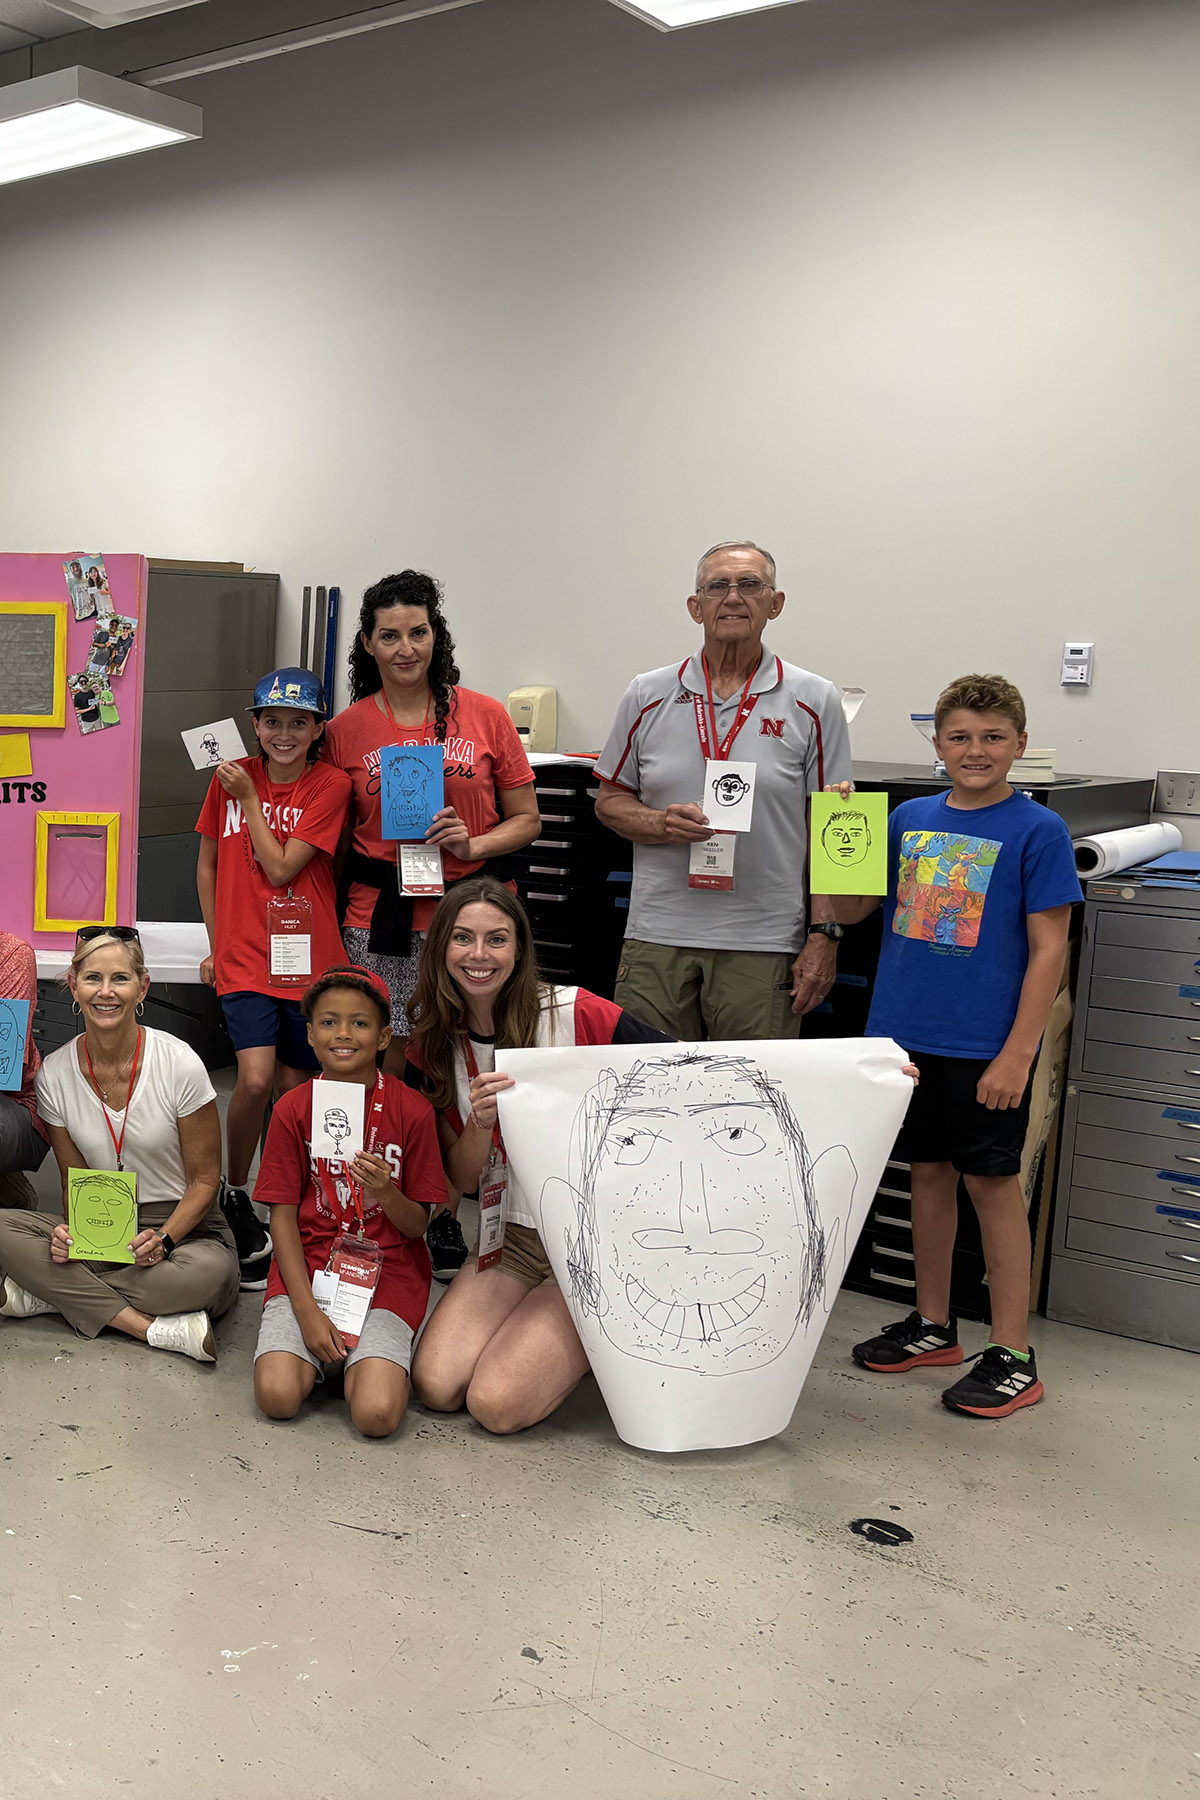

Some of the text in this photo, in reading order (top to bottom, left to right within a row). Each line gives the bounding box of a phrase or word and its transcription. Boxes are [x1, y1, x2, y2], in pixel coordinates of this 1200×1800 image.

[759, 717, 785, 740] N
[374, 1103, 383, 1112] N
[75, 1247, 104, 1256] Grandma
